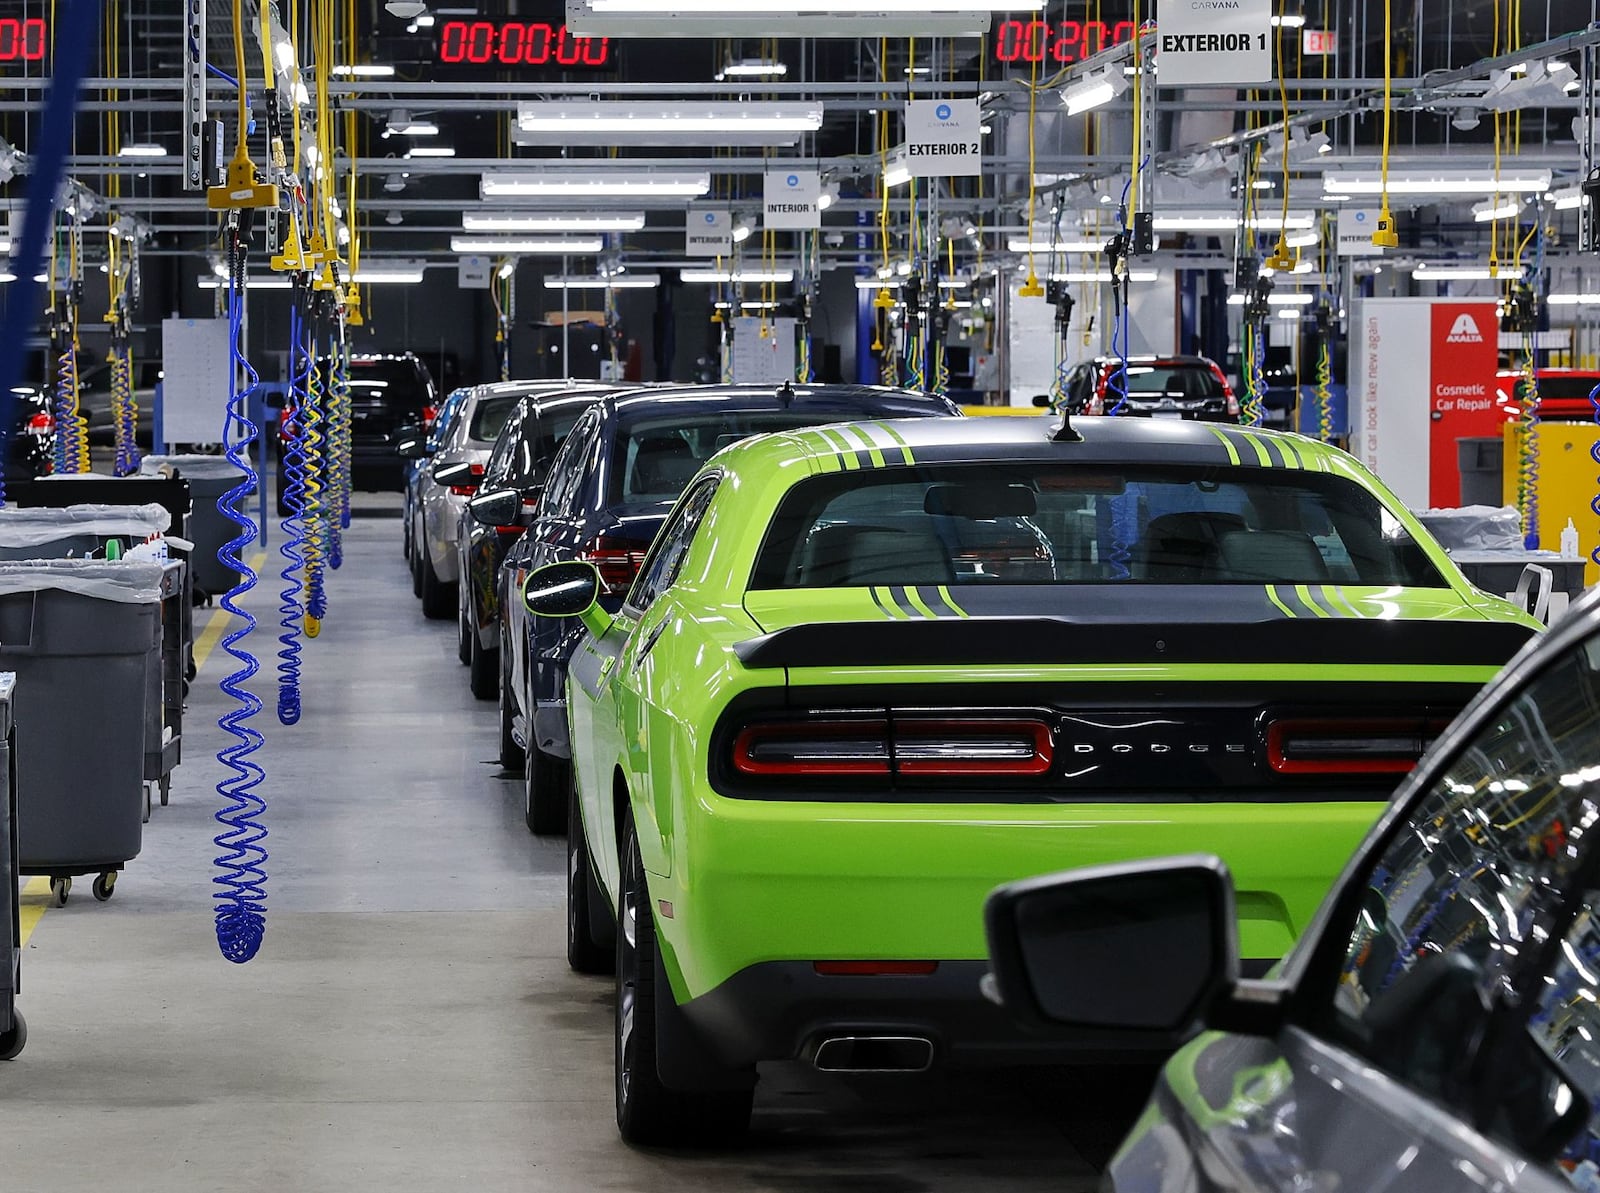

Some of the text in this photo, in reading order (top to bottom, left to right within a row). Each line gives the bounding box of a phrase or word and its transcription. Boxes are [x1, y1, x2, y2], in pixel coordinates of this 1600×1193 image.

[1191, 1, 1240, 10] CARVANA
[441, 21, 609, 65] 00:00:00
[996, 20, 1146, 62] 00:20:0
[1162, 33, 1266, 52] EXTERIOR 1
[1310, 32, 1335, 51] EXT
[909, 143, 979, 156] EXTERIOR 2
[767, 203, 817, 213] INTERIOR 1
[689, 236, 730, 244] INTERIOR 2
[1367, 316, 1381, 350] again
[1446, 334, 1483, 343] AXALTA
[1368, 352, 1378, 378] new
[1366, 382, 1378, 402] like
[1436, 384, 1485, 396] Cosmetic
[1436, 398, 1492, 412] Car Repair
[1366, 406, 1378, 430] look
[1367, 434, 1378, 451] car
[1074, 743, 1245, 753] DODGE
